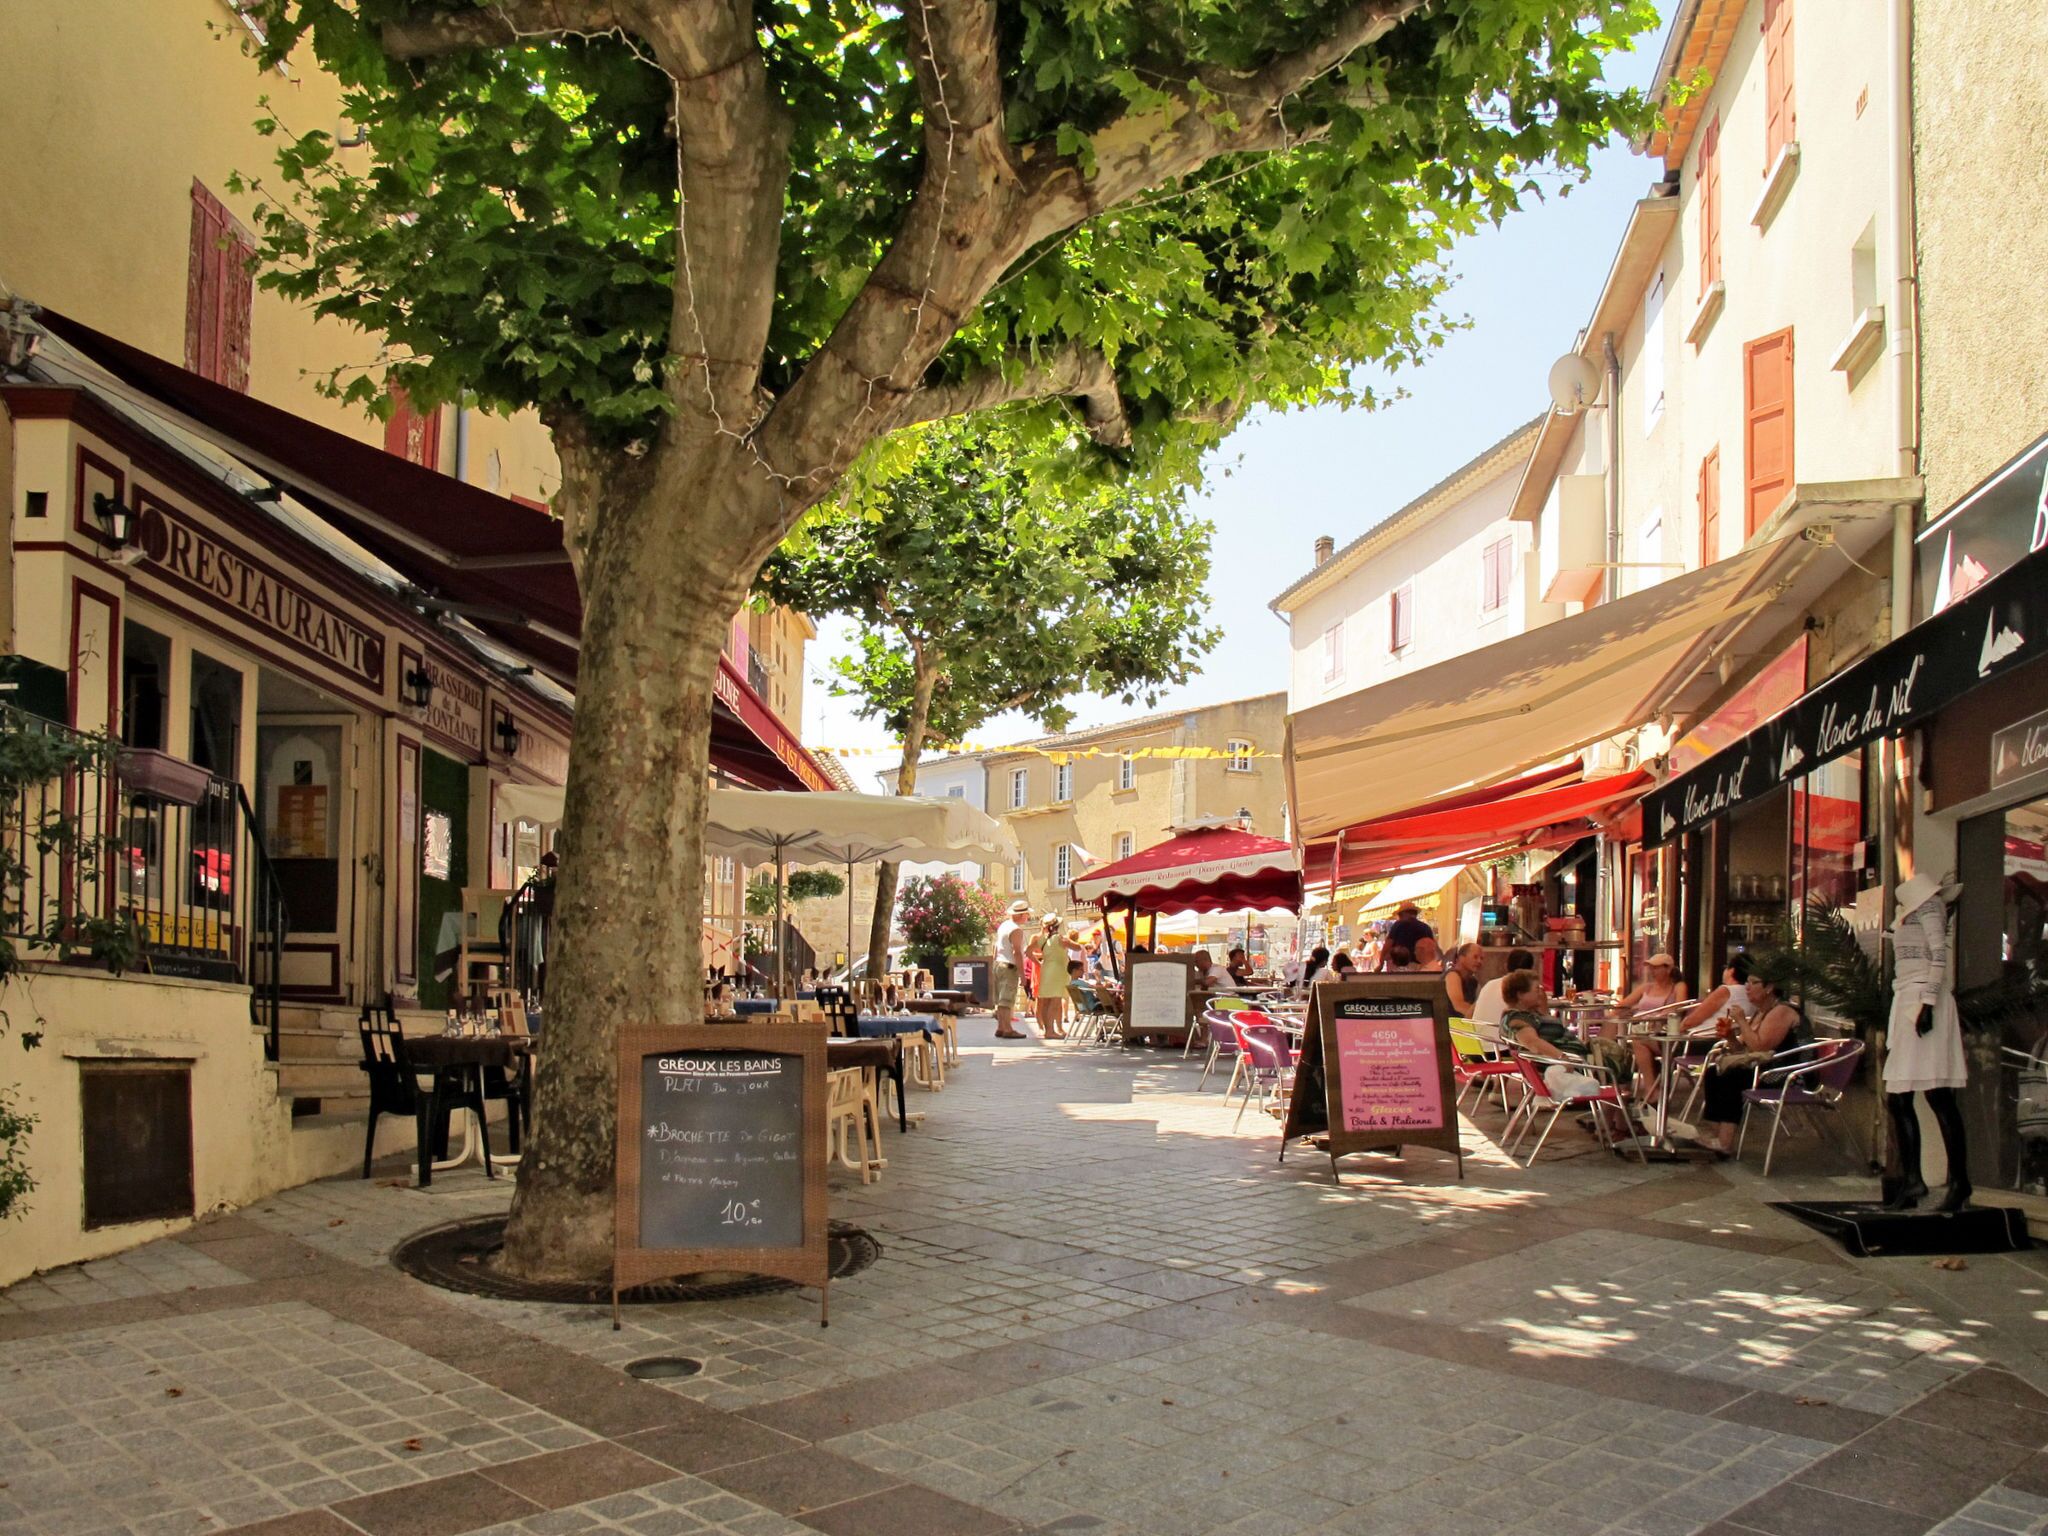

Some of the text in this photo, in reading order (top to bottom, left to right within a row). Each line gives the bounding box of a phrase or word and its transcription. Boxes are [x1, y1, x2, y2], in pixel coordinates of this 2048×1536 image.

[167, 521, 364, 671] RESTAURANT
[425, 662, 481, 711] BRASSERIE
[426, 705, 479, 747] FONTAINE
[1816, 702, 1858, 757] blanc
[1861, 684, 1882, 733] du
[1683, 784, 1709, 826] blanc
[1711, 774, 1724, 811] du
[1344, 1004, 1379, 1012] GRÉOUX
[1396, 1004, 1422, 1012] BAINS
[658, 1058, 782, 1071] GRÉOUX LES BAINS
[656, 1122, 730, 1143] BROCHETTE
[1350, 1115, 1432, 1126] Boule & Italienne
